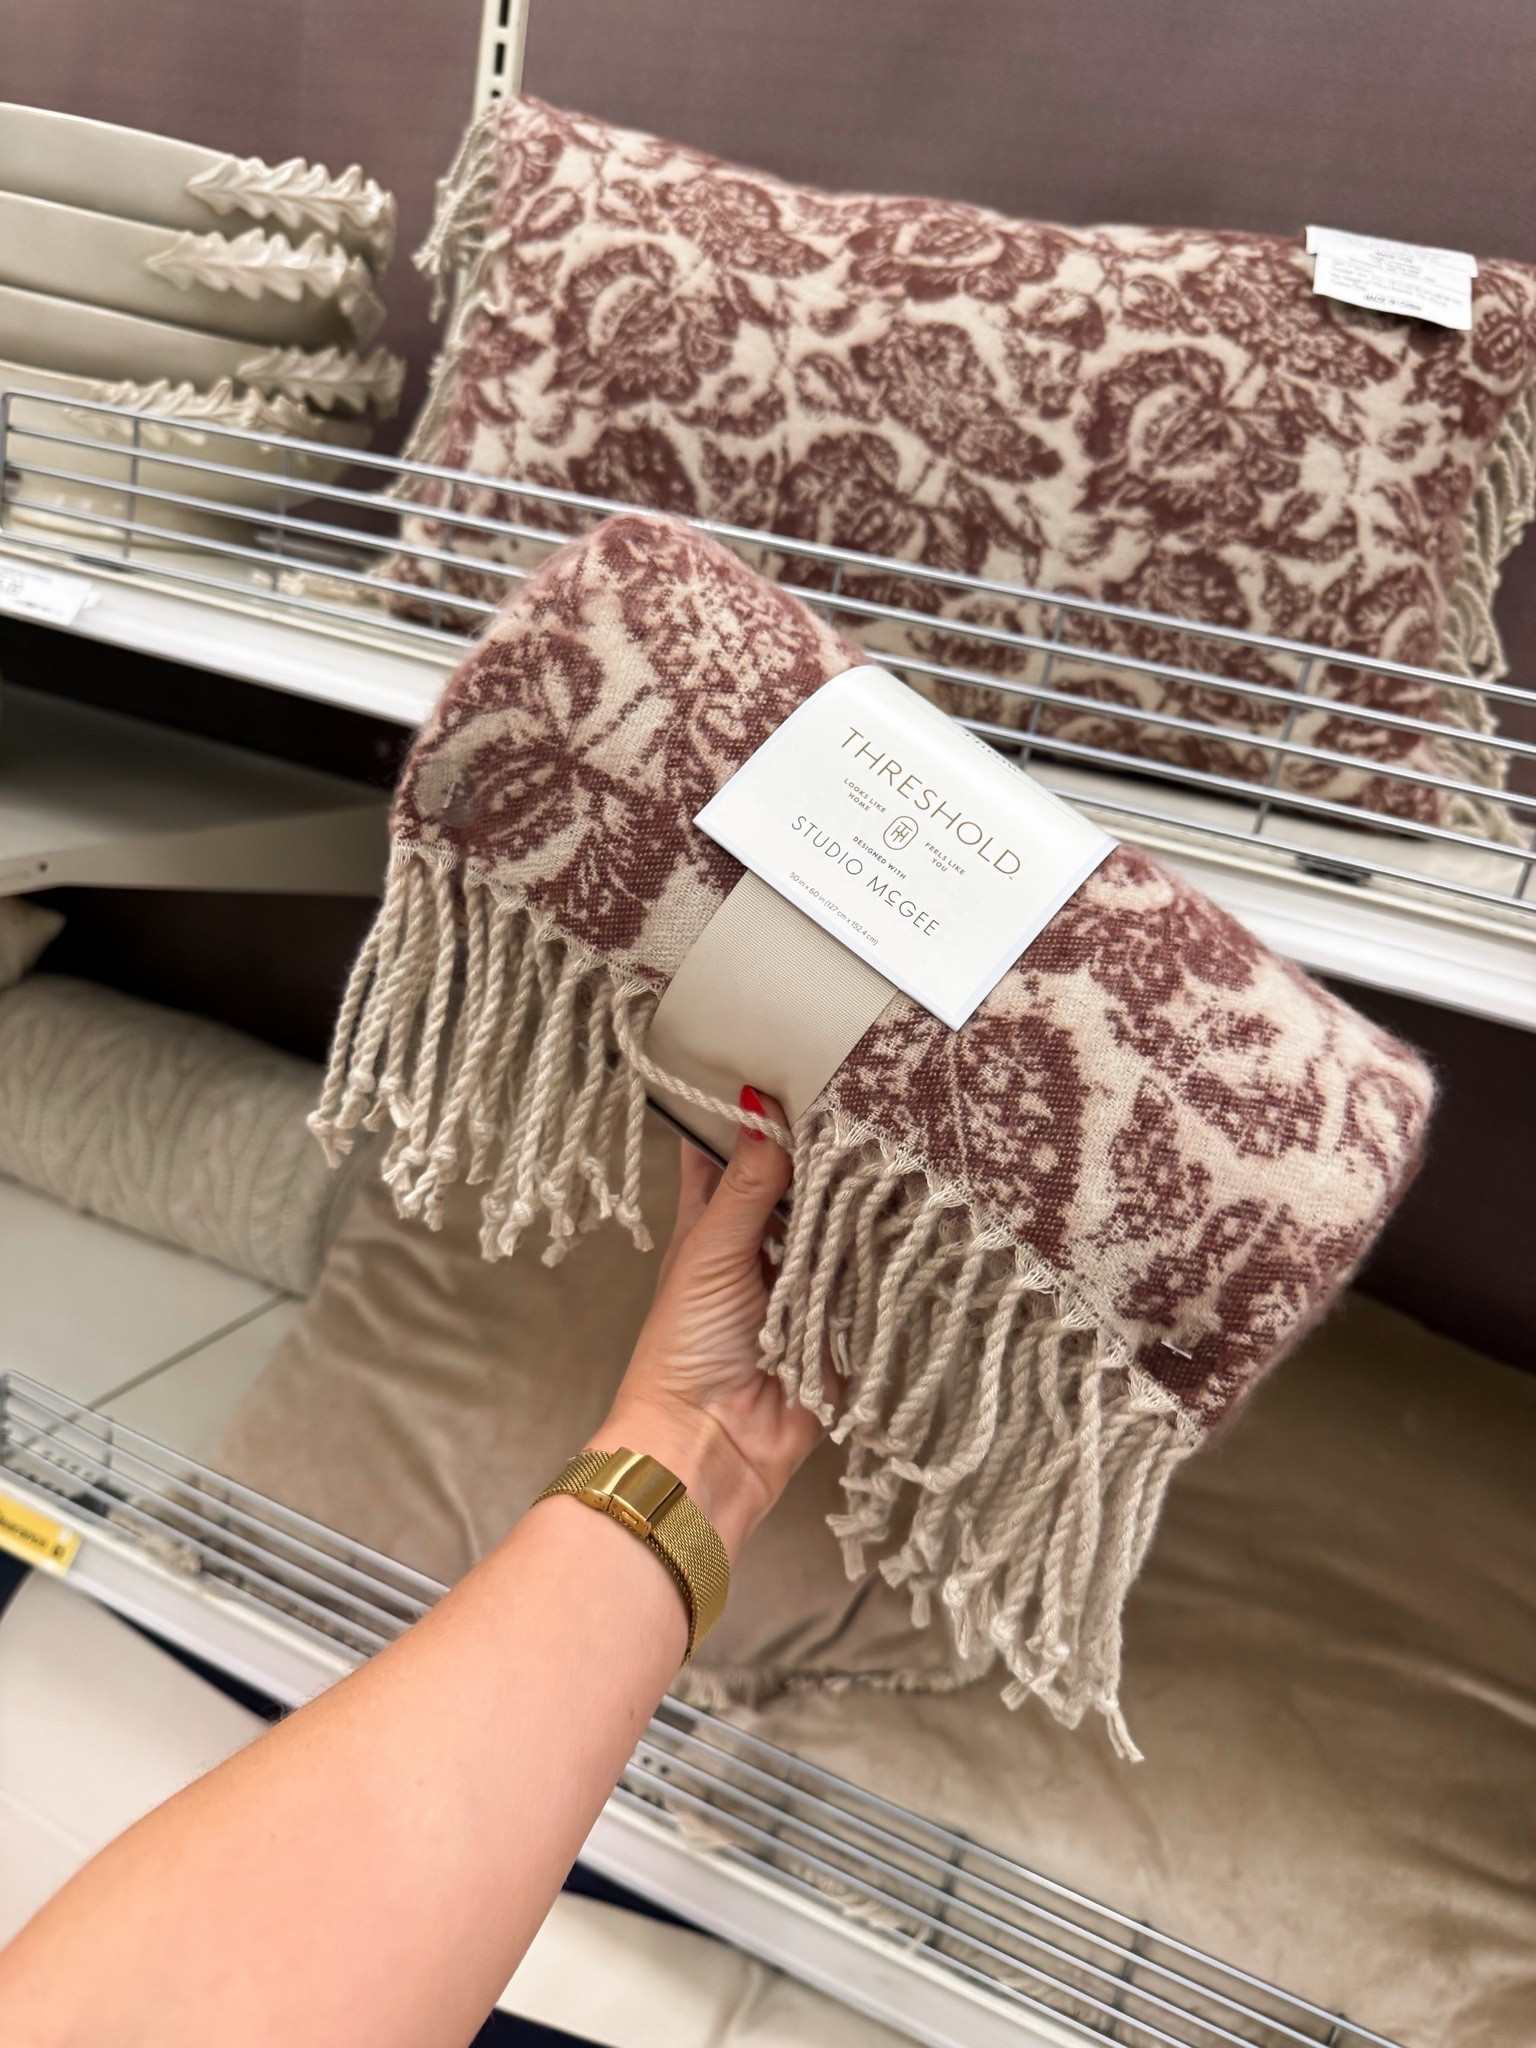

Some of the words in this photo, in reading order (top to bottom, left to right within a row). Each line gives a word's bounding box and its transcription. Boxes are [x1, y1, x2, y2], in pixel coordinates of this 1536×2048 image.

[841, 726, 1021, 875] THRESHOLD
[844, 778, 869, 799] LOOKS
[869, 798, 887, 813] LIKE
[848, 792, 871, 812] HOME
[791, 815, 863, 875] STUDIO
[852, 836, 887, 865] DESIGNED
[888, 863, 907, 880] WITH
[925, 842, 948, 861] FEELS
[948, 860, 966, 876] LIKE
[931, 857, 949, 873] YOU
[789, 871, 800, 882] 50
[798, 878, 806, 887] in
[809, 887, 820, 898] 60
[818, 894, 826, 904] in
[823, 900, 839, 912] (127
[837, 911, 847, 921] cm
[850, 921, 868, 936] 152.4
[866, 933, 879, 946] cm)
